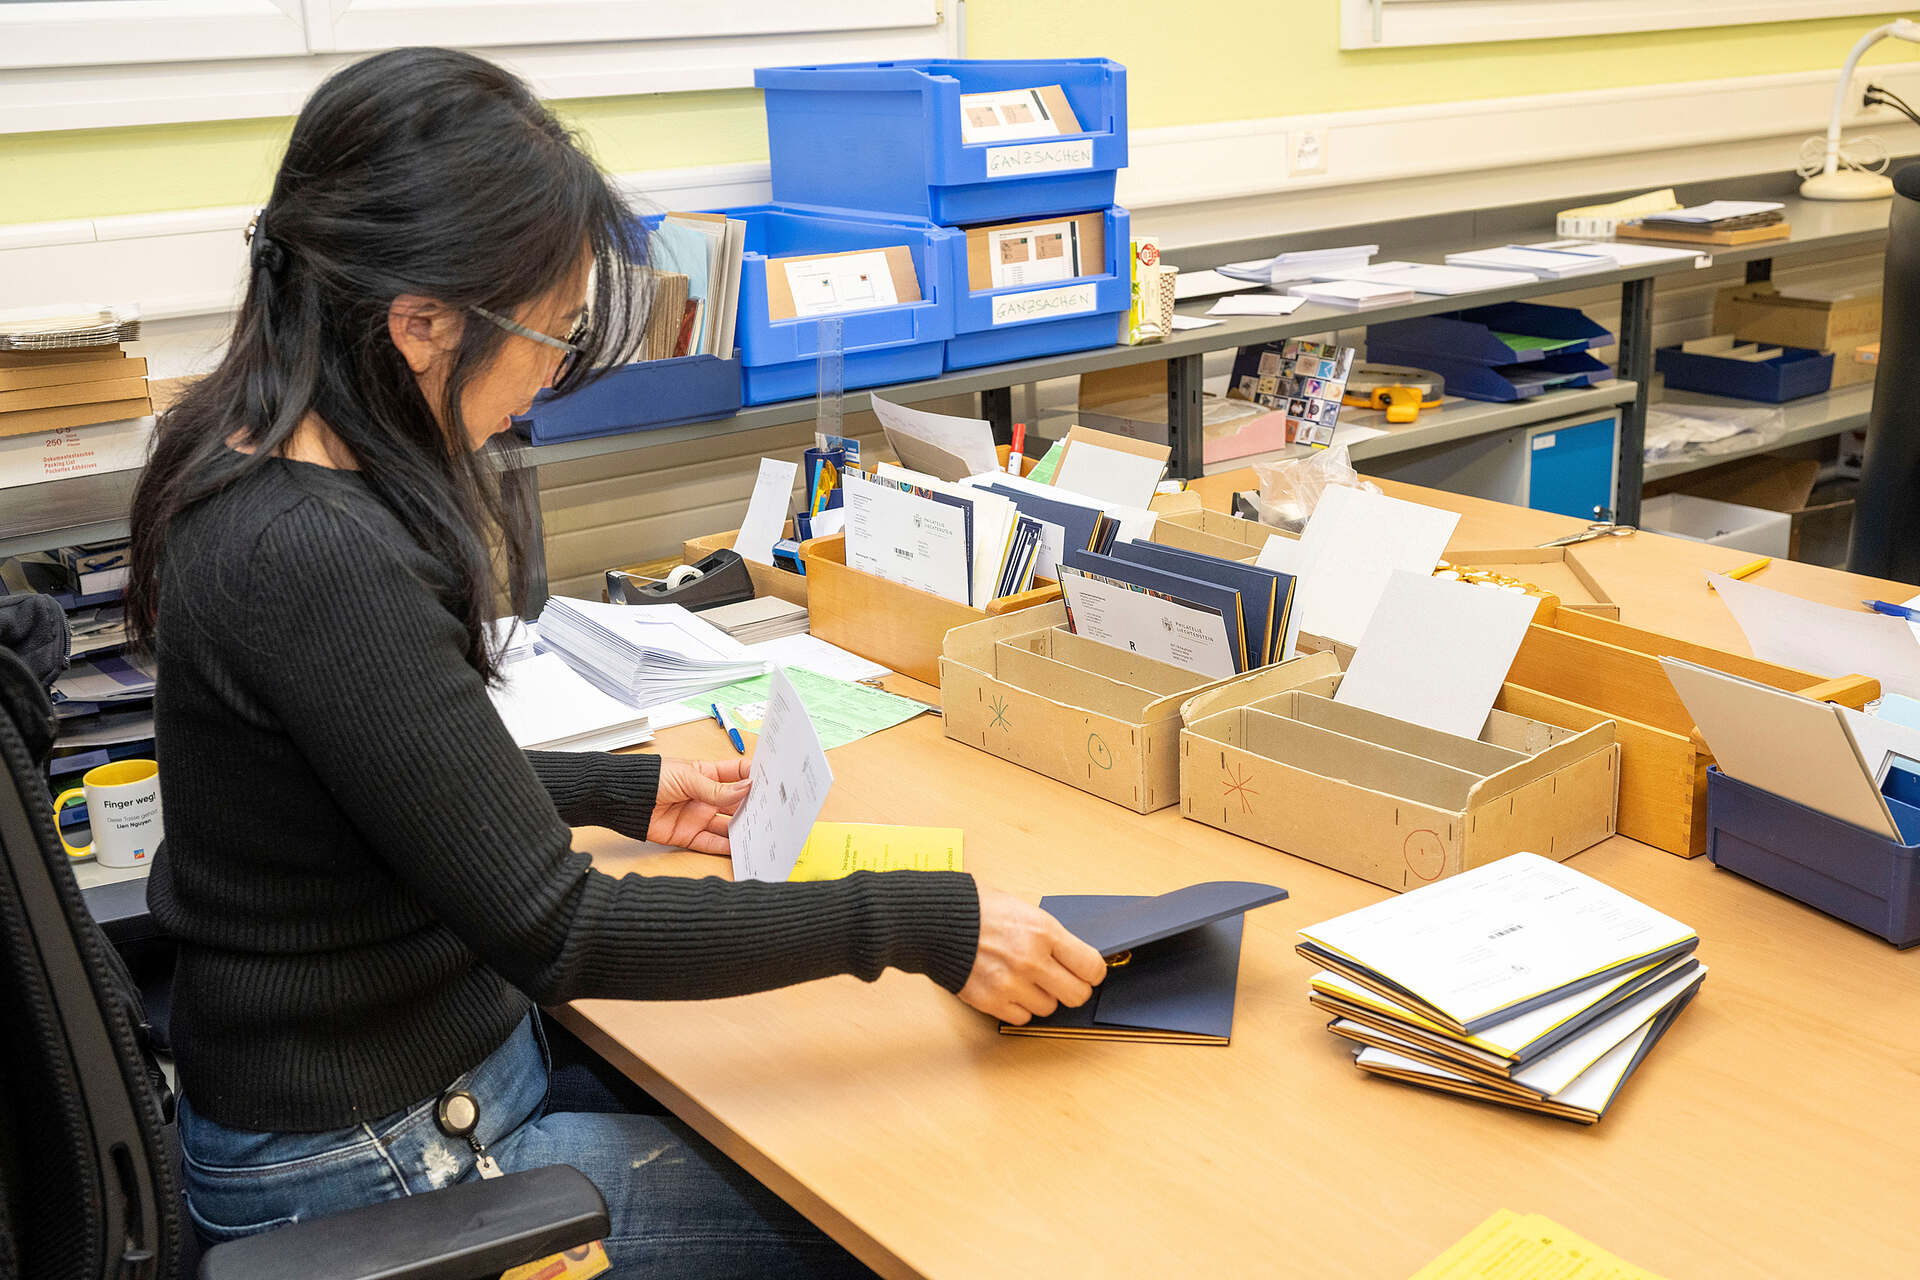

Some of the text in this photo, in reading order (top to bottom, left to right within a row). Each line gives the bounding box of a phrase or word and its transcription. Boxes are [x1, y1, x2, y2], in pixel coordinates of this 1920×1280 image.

[990, 149, 1090, 171] GANZSACHEN
[997, 292, 1089, 318] GANZSACHEN
[46, 439, 62, 447] 250
[44, 461, 65, 469] Packing
[1129, 640, 1137, 652] R
[104, 792, 156, 809] Finger weg!
[130, 819, 152, 828] Nguyen
